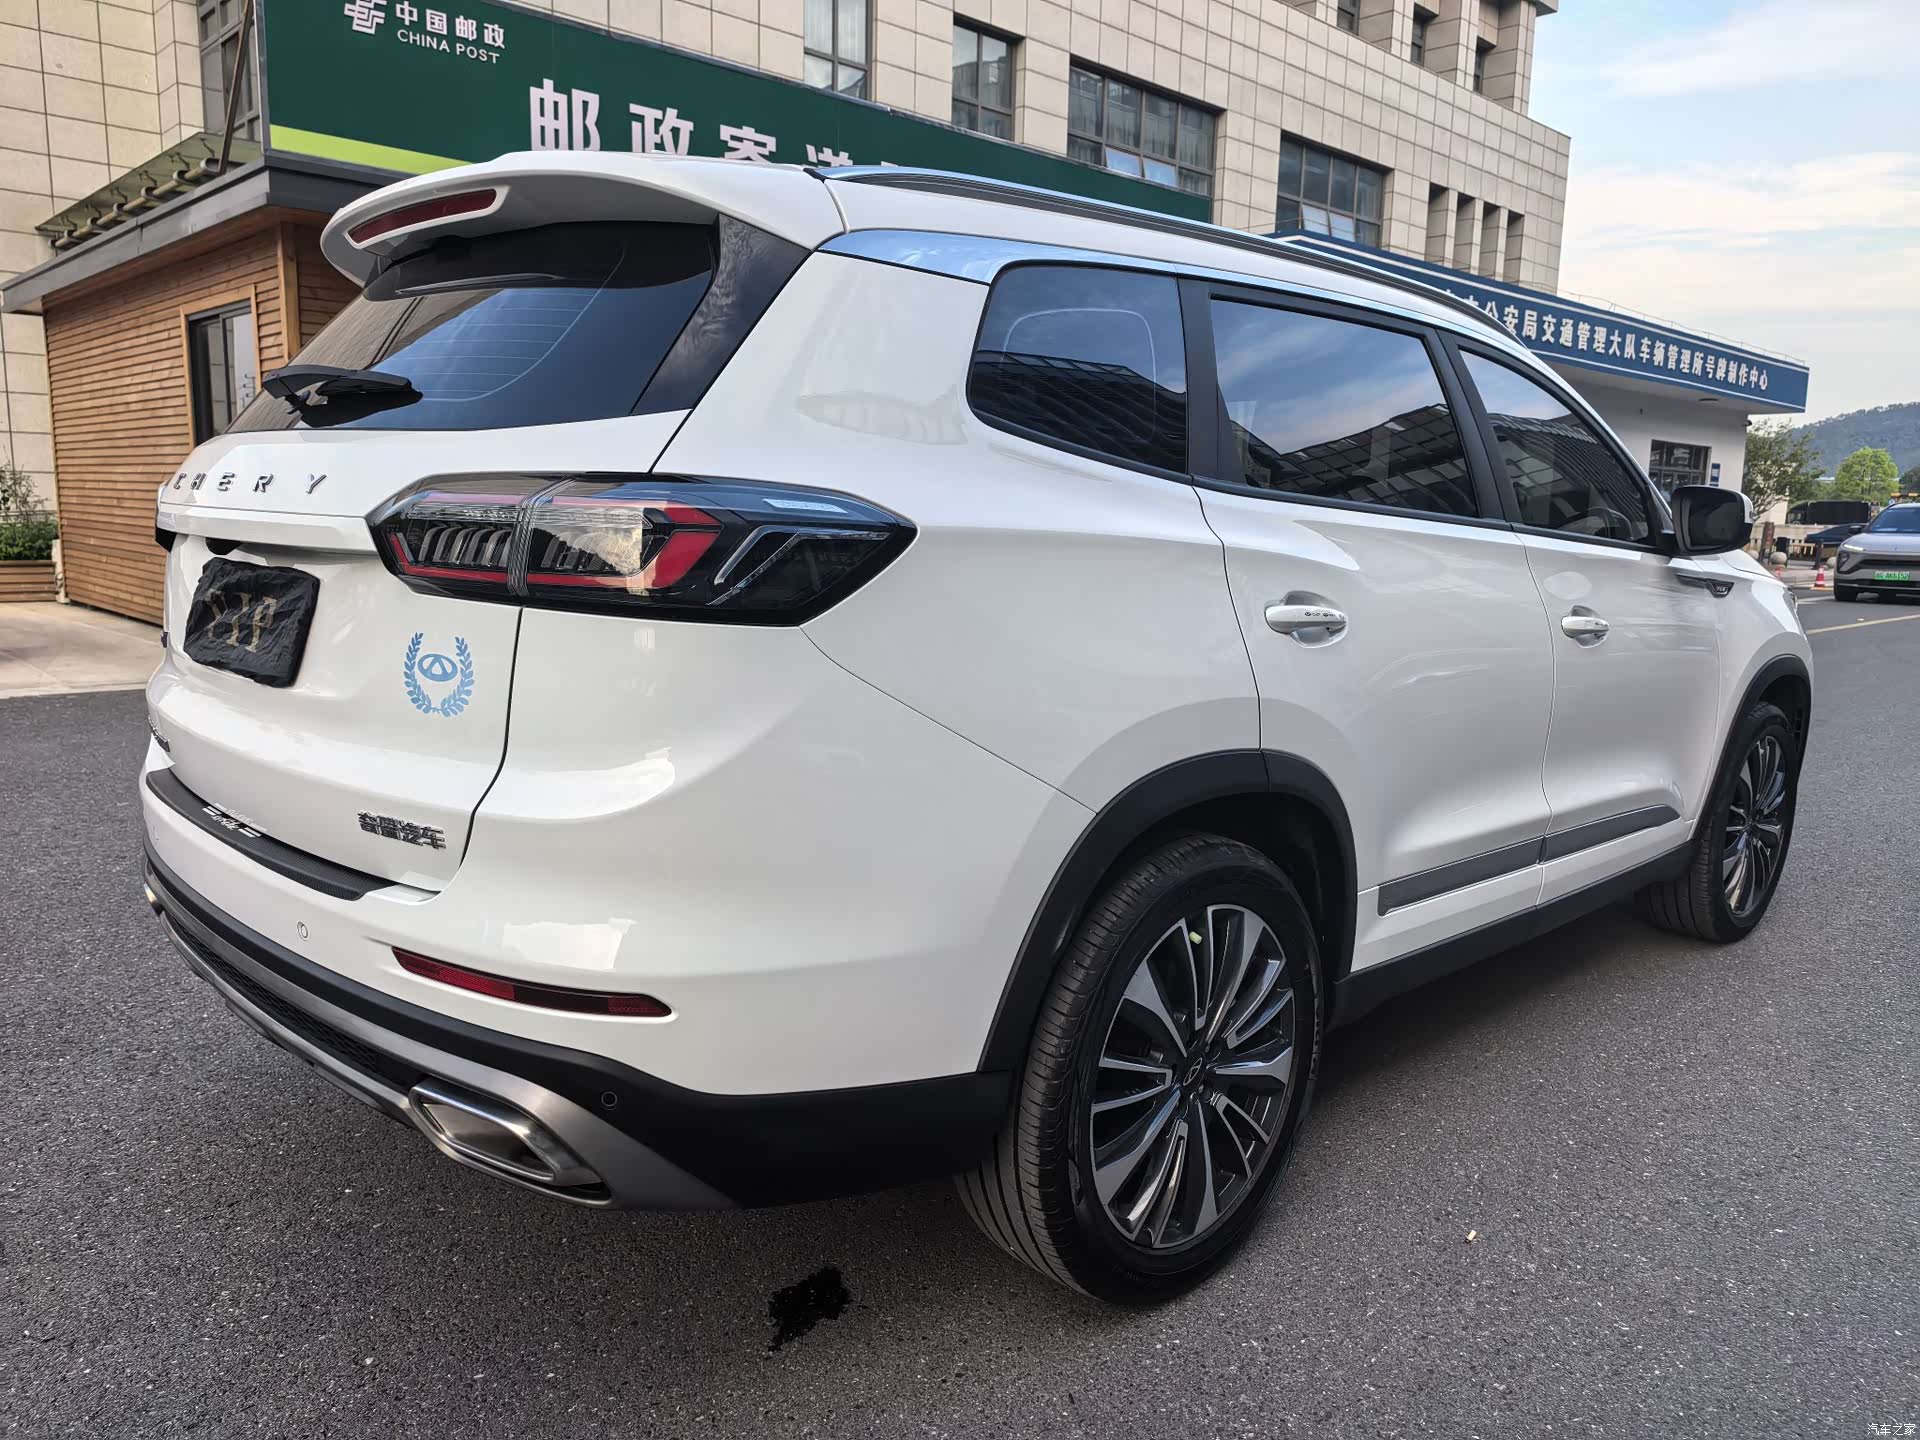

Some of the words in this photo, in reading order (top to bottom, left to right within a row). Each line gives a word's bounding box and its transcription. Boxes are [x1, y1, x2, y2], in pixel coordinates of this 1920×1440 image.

[395, 1, 505, 49] 中国邮政
[397, 29, 450, 53] CHINA
[456, 43, 500, 64] POST
[173, 472, 327, 495] CHERY
